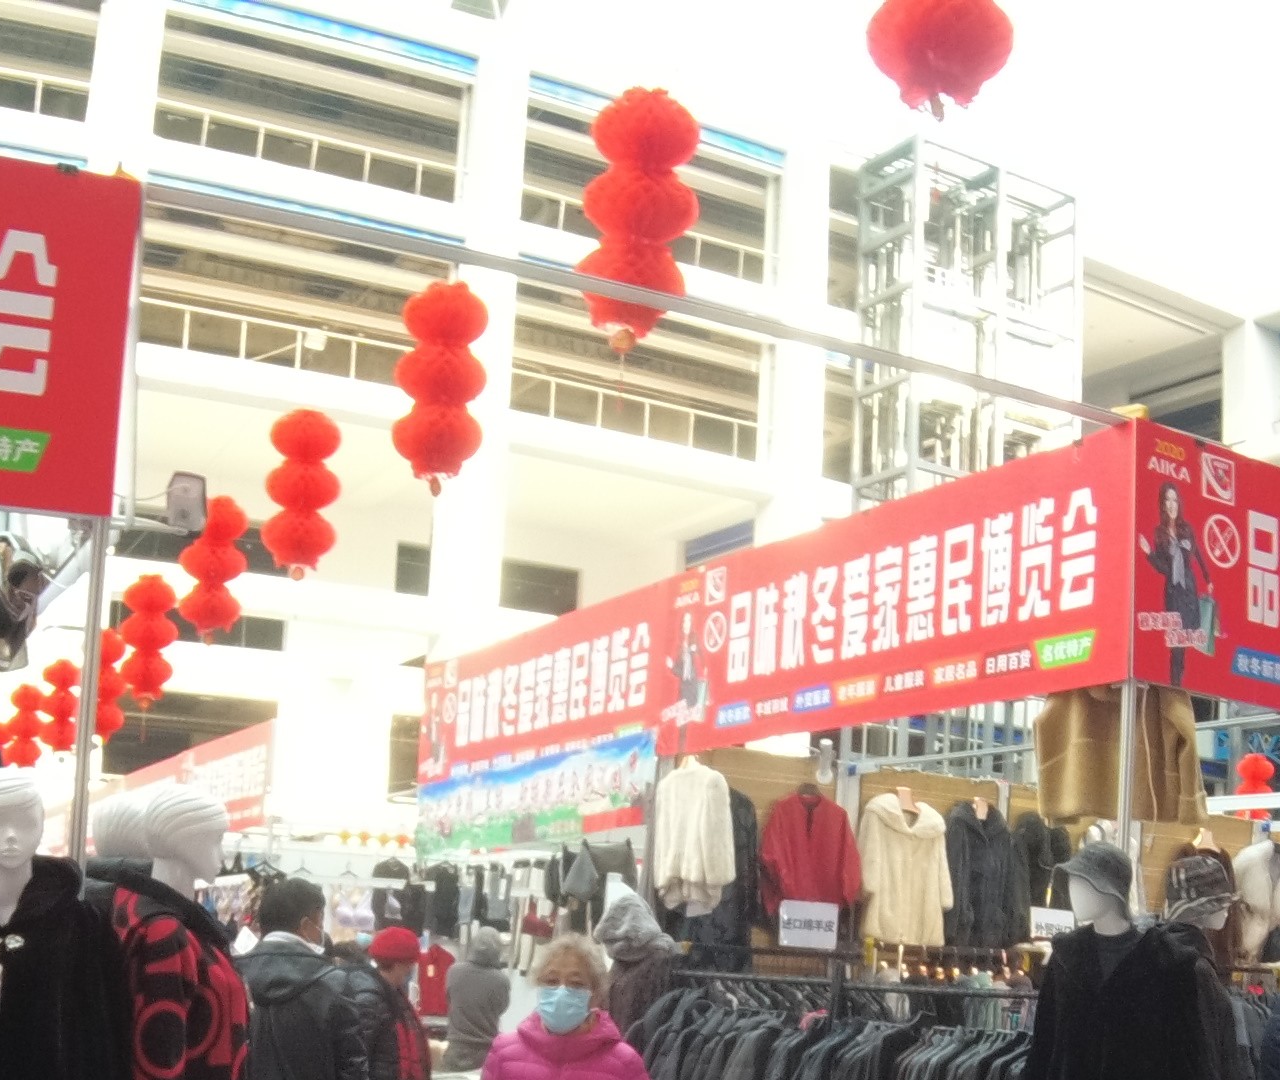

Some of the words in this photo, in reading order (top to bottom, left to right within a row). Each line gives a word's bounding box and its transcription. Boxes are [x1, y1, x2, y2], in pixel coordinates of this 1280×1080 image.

[1147, 456, 1191, 484] AIKA
[727, 487, 1098, 683] 品味秋冬爱家惠民博览会
[985, 649, 1032, 675] 日用百货
[1041, 636, 1093, 663] 名优特产
